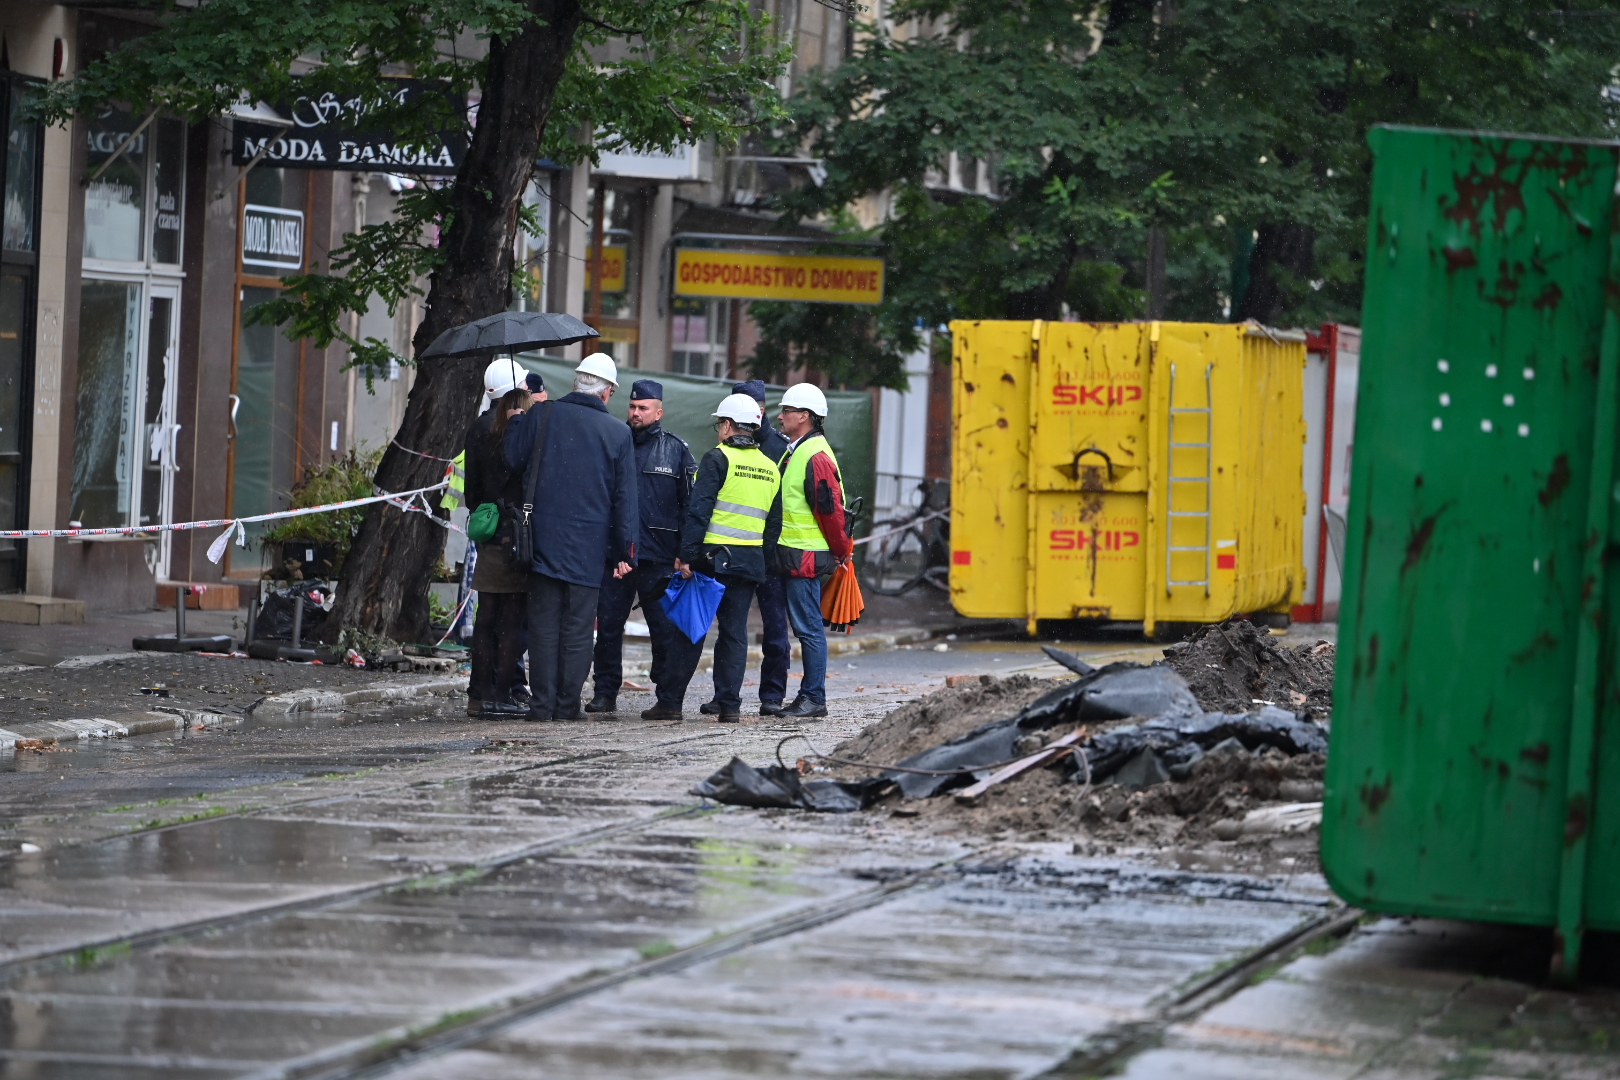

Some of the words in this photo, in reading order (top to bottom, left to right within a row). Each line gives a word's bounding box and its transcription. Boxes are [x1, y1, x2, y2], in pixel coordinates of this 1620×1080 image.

[242, 136, 327, 162] MODA
[338, 140, 455, 168] DAMSKA
[244, 215, 268, 253] MODA
[269, 218, 300, 257] DAMSKA
[680, 261, 806, 290] GOSPODARSTWO
[810, 268, 879, 292] DOMOWE
[1052, 384, 1143, 406] SKIP
[654, 466, 673, 474] POLICJA
[1050, 529, 1140, 551] SKIP
